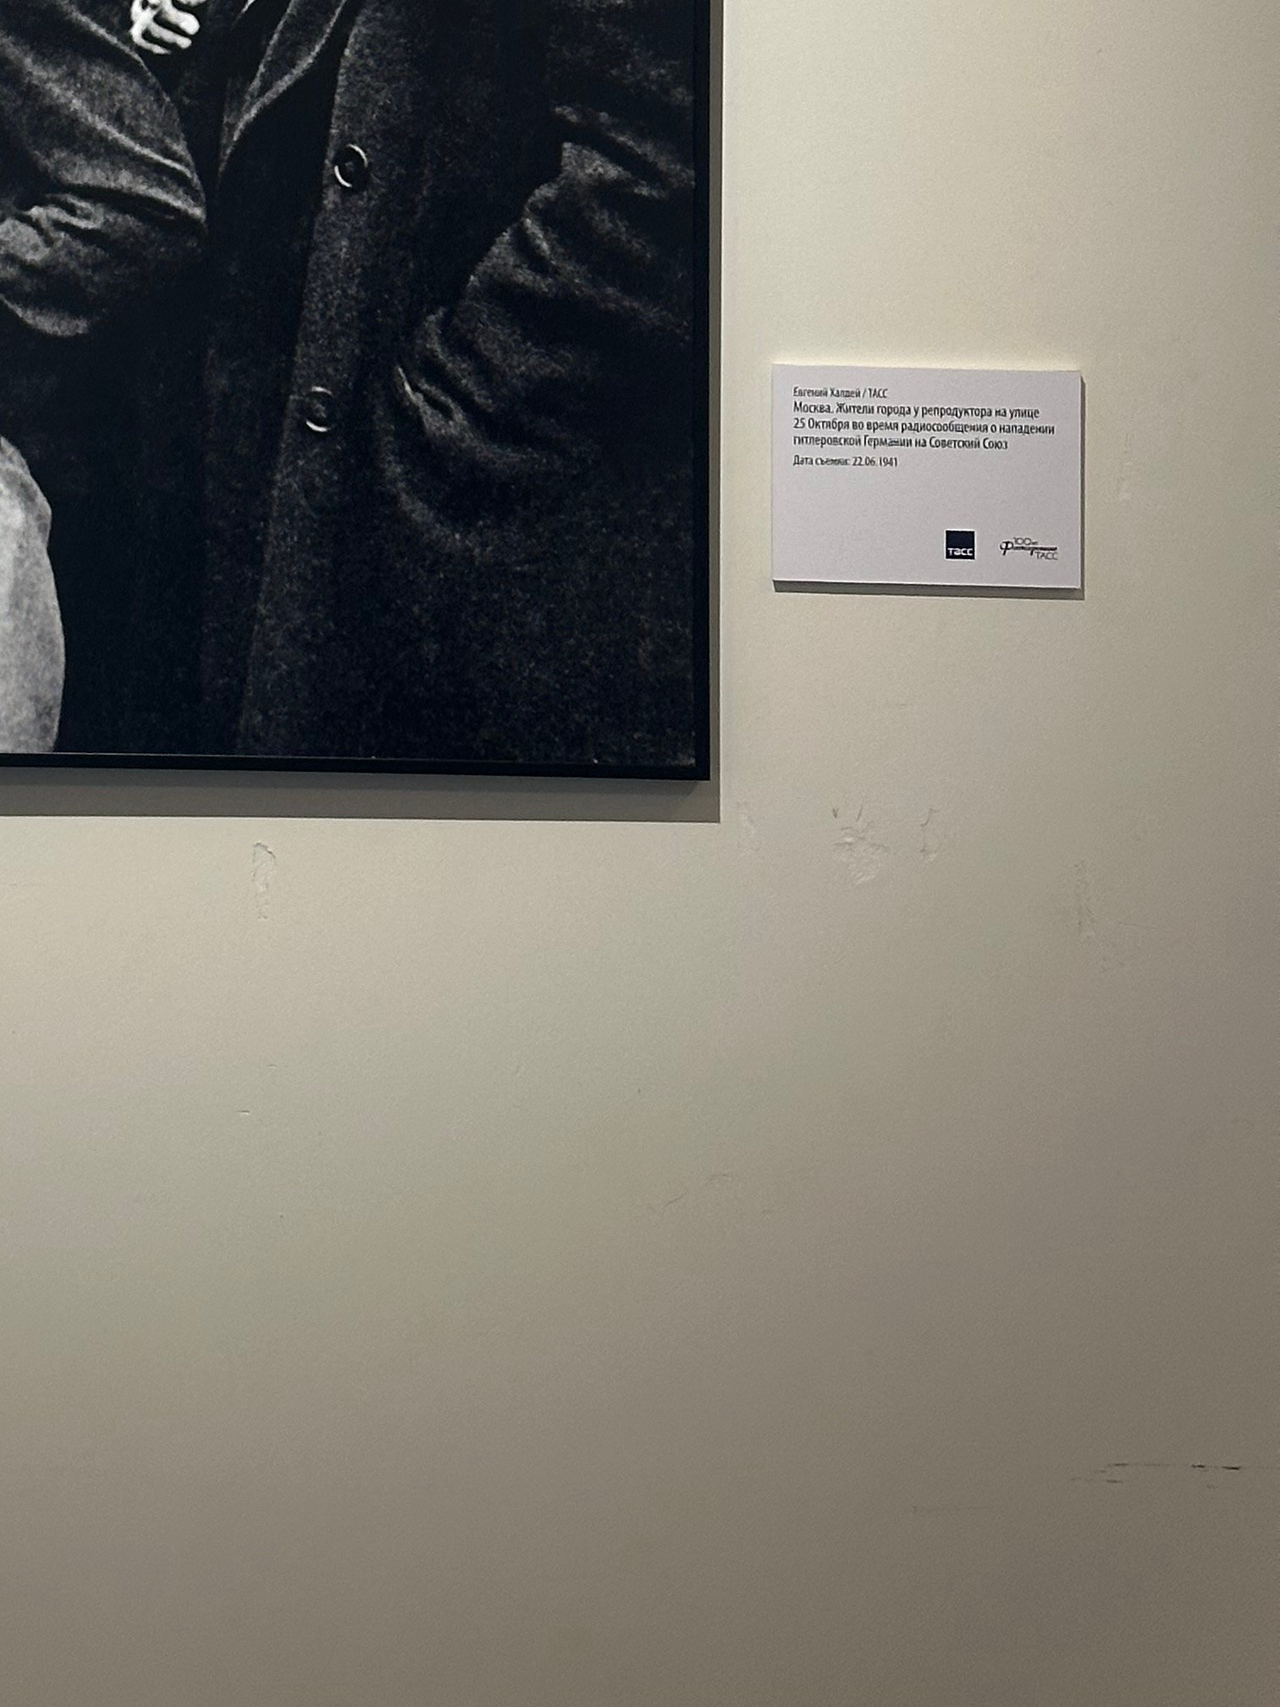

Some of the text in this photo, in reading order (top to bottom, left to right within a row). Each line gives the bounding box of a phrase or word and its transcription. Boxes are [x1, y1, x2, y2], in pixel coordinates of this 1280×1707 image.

[868, 388, 889, 398] ТАСС
[793, 400, 1040, 420] Москва. Жители города у репродуктора на улице
[793, 417, 1055, 436] 25 Октября во время радиосообщения о нападении
[793, 434, 1008, 450] гитлеровской Германии на Советский Союз
[793, 454, 813, 466] Дата
